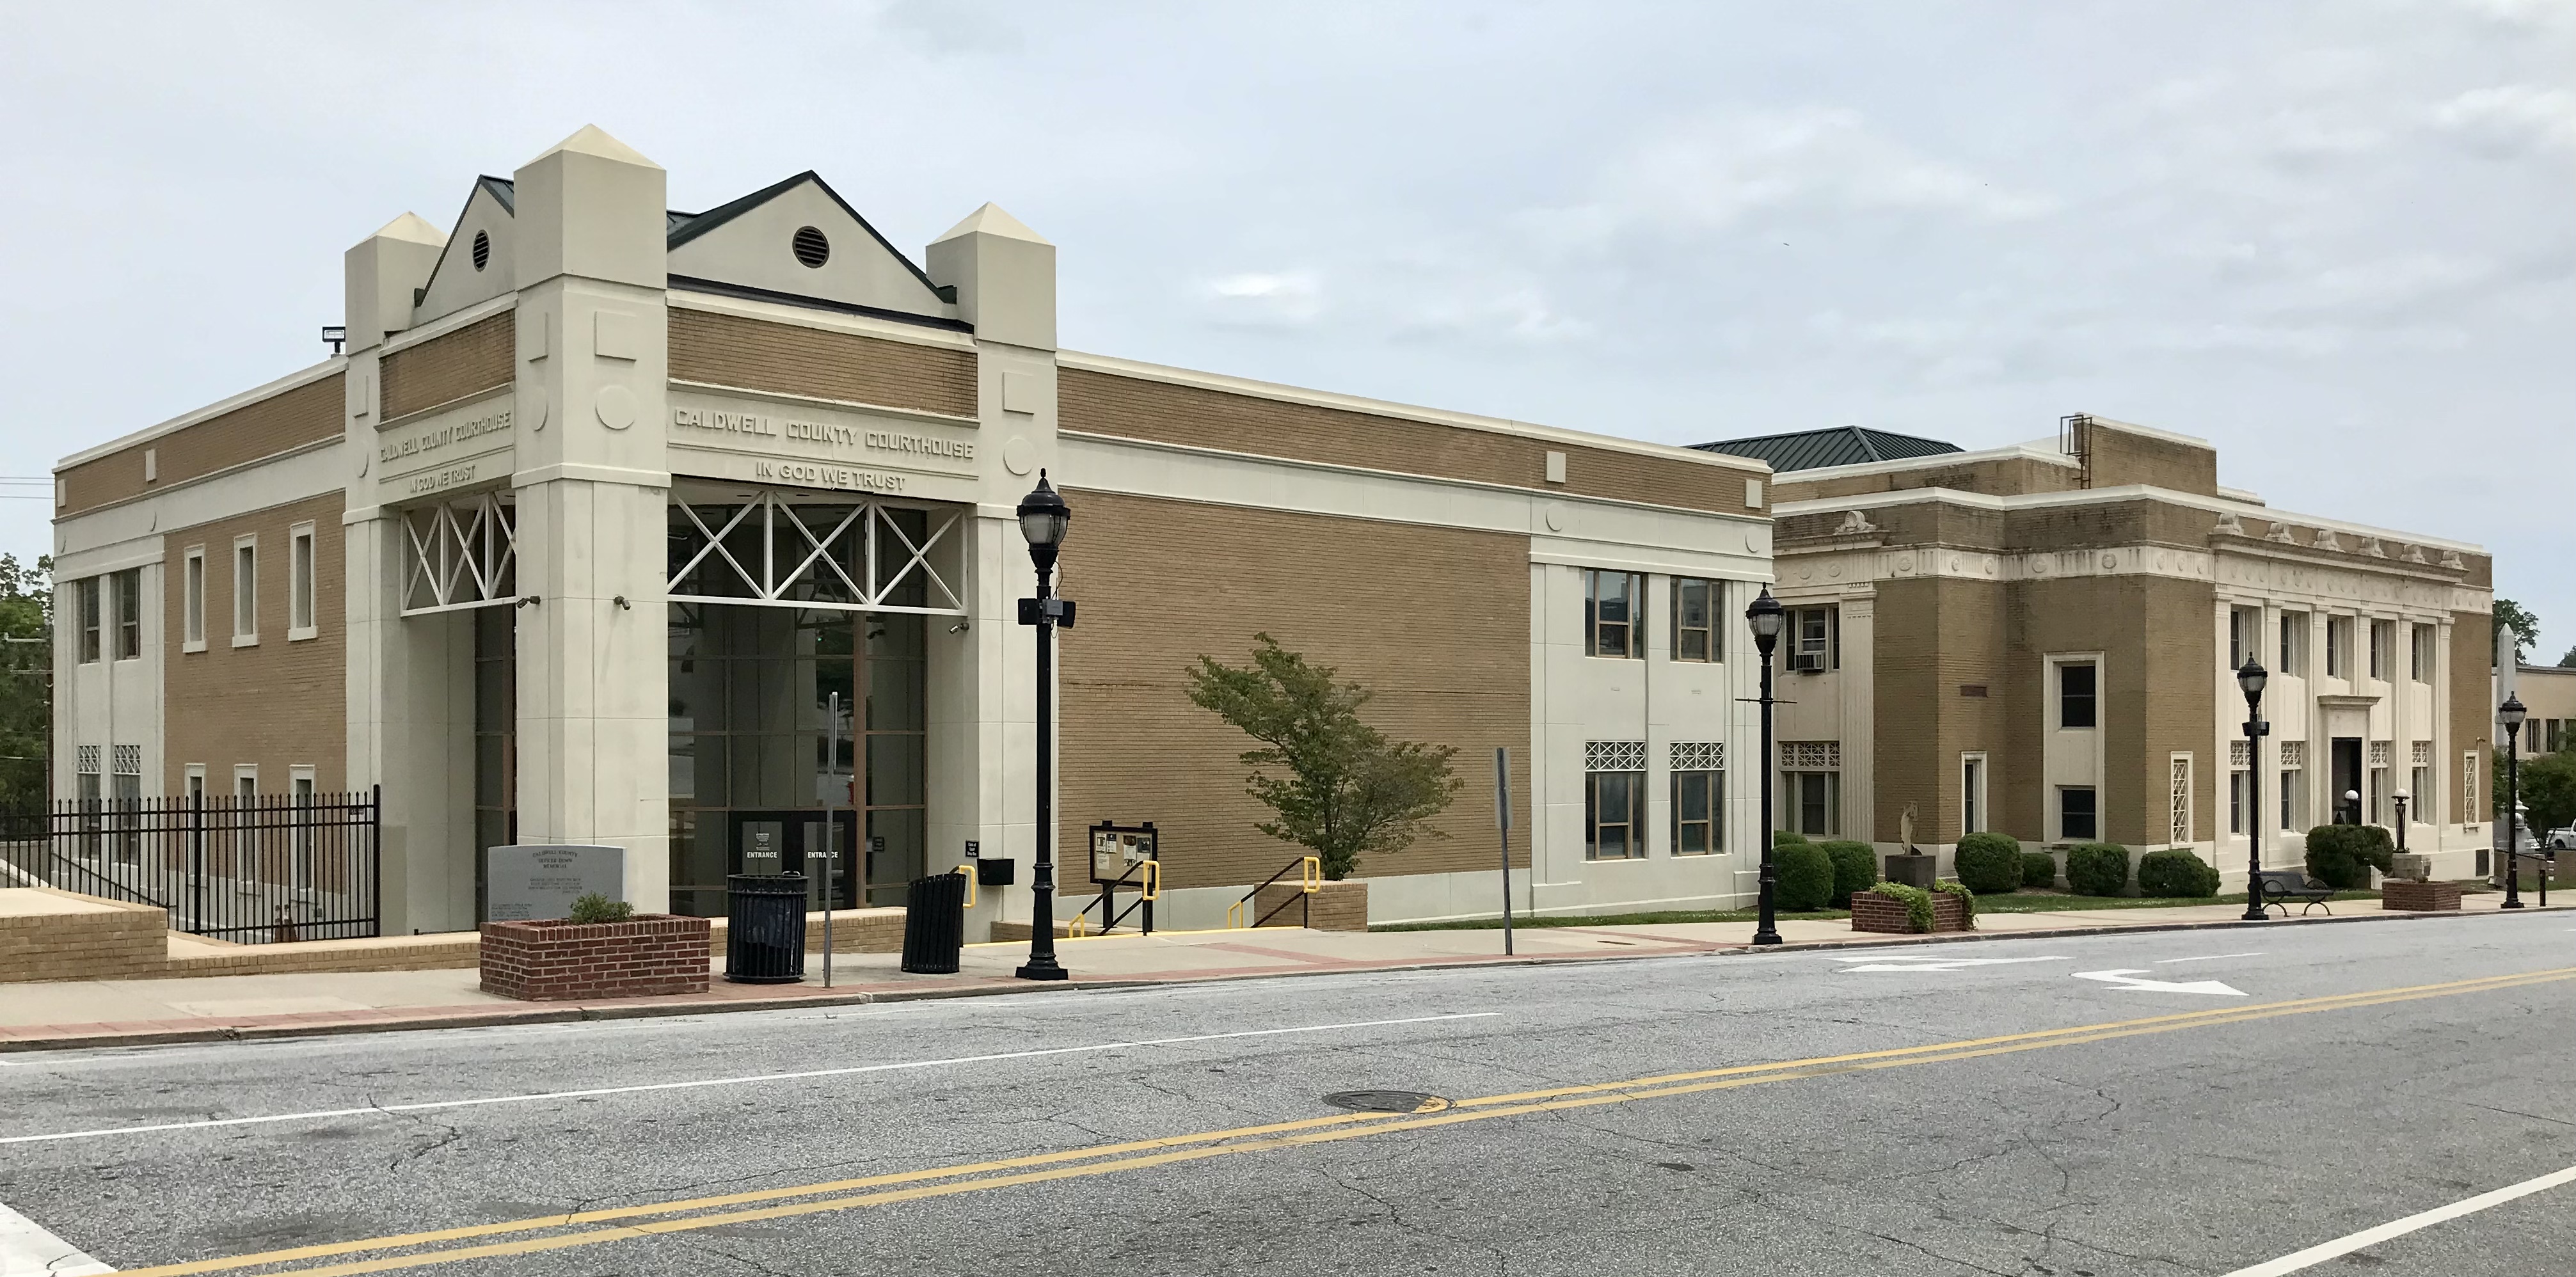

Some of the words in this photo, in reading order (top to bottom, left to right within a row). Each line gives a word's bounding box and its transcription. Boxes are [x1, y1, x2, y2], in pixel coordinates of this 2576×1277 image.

[381, 438, 419, 462] CALDWELL
[422, 427, 452, 450] COUNTY
[456, 411, 511, 441] COURTHOUSE
[675, 407, 776, 436] CALDWELL
[786, 422, 858, 445] COUNTY
[866, 431, 974, 459] COURTHOUSE
[410, 479, 417, 493] IN
[418, 477, 435, 491] GOD
[437, 472, 449, 486] WE
[451, 465, 476, 483] TRUST
[756, 461, 773, 477] IN
[779, 464, 816, 480] GOD
[821, 468, 848, 484] WE
[853, 472, 906, 490] TRUST
